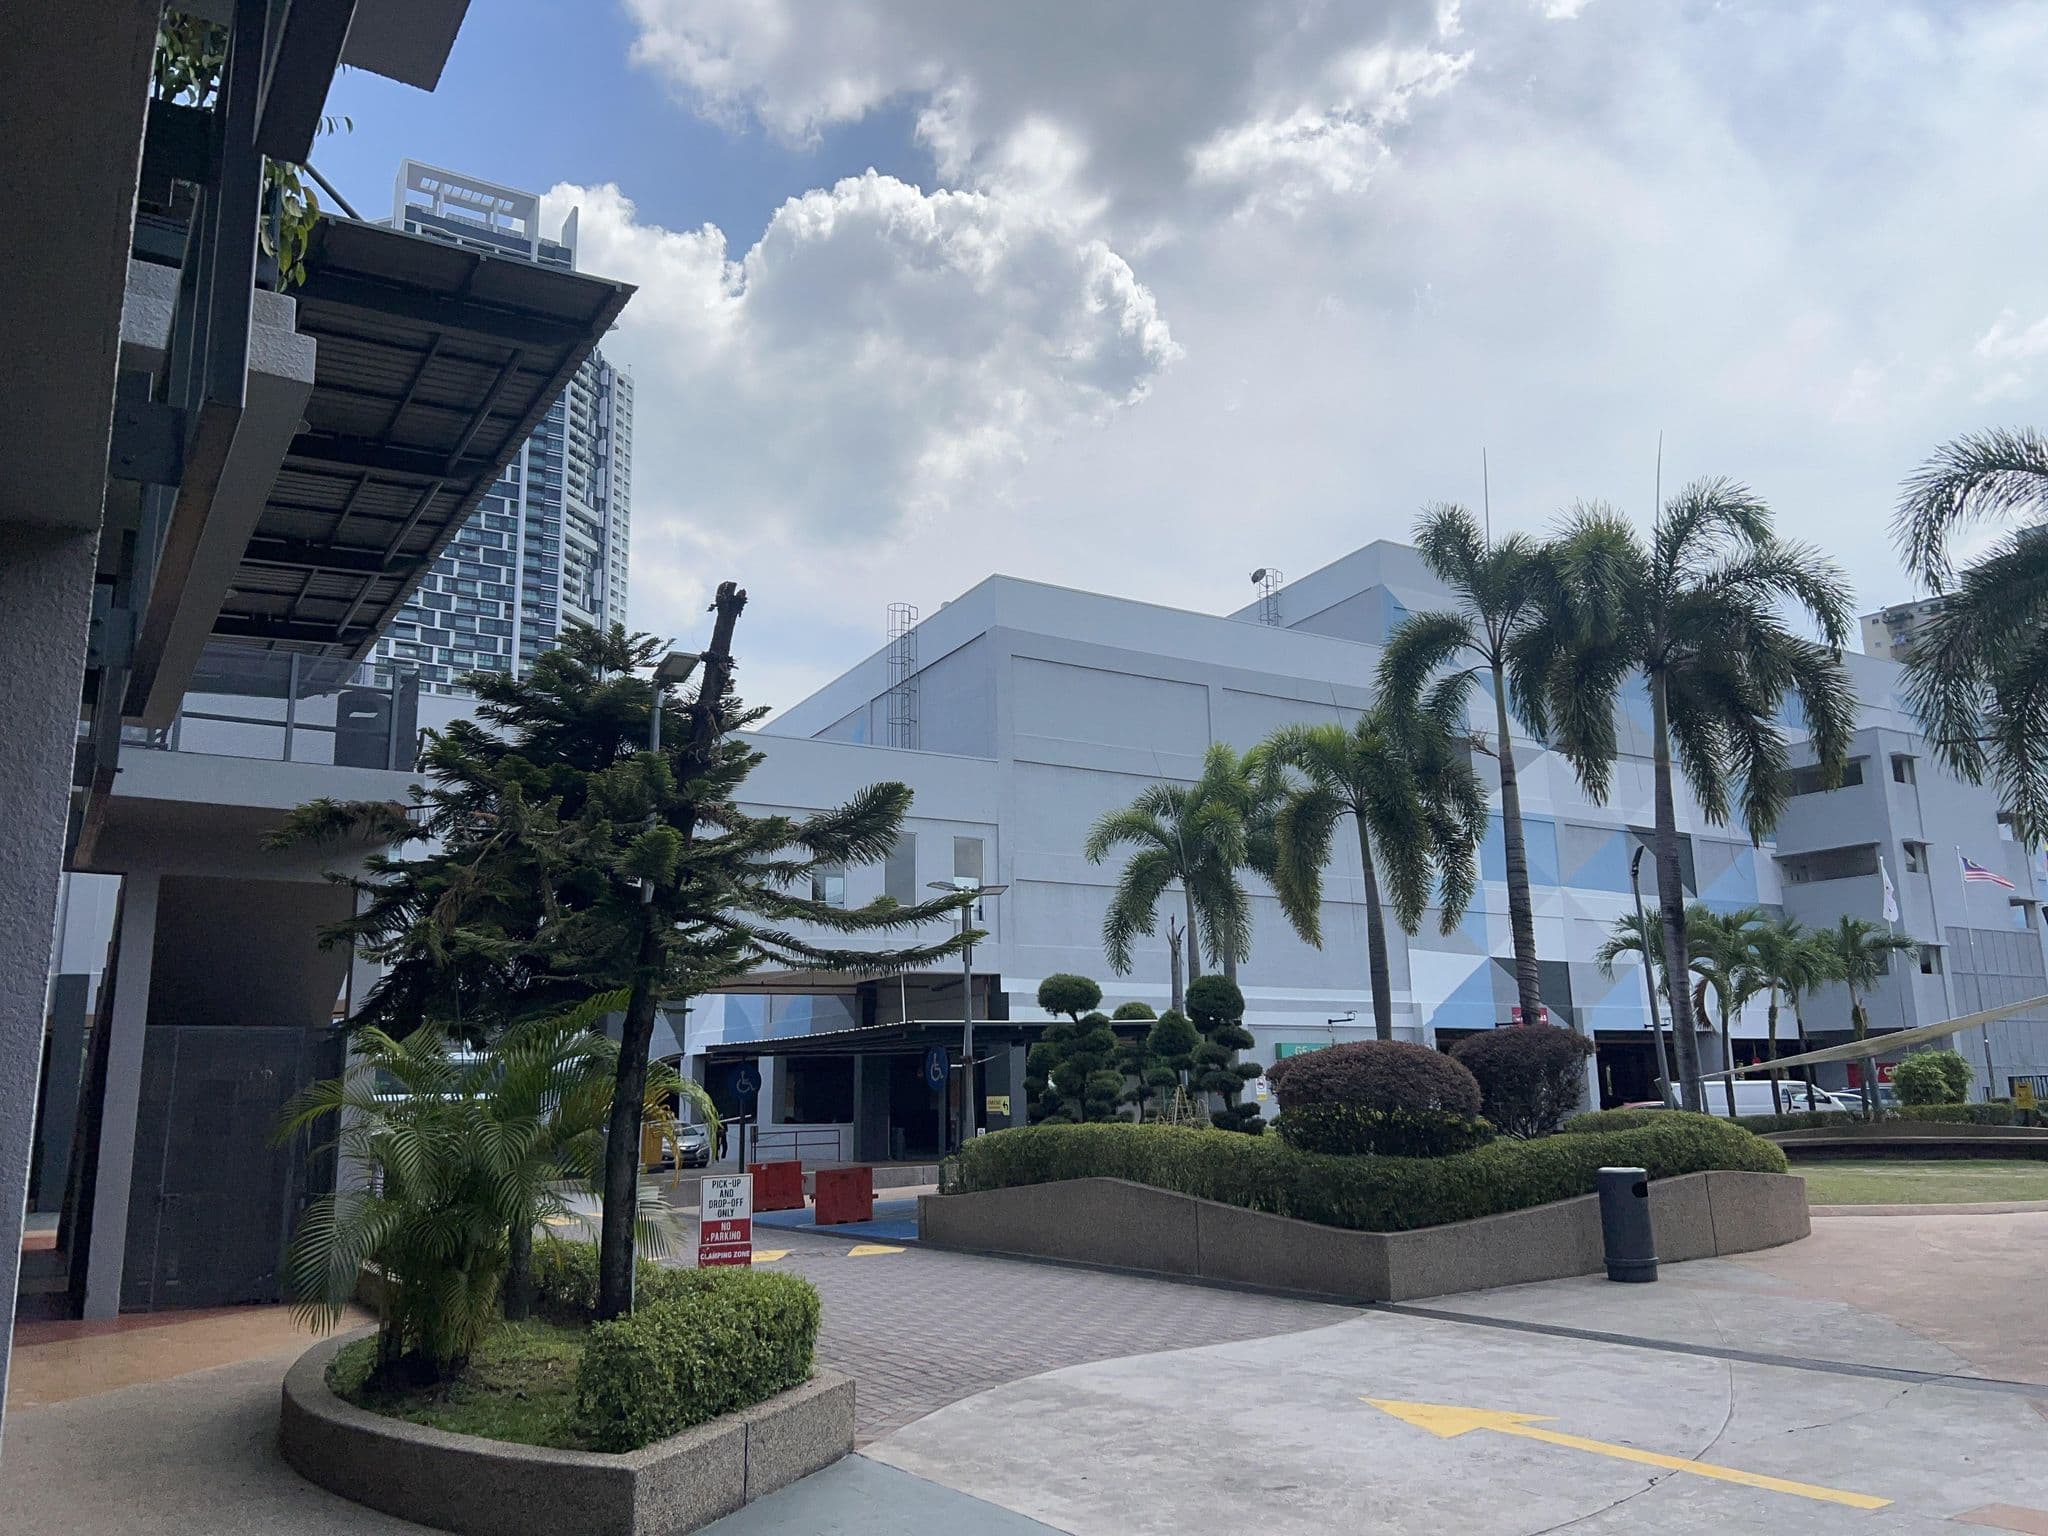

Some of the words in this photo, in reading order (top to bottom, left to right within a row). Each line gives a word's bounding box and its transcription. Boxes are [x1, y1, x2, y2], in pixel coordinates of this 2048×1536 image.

[712, 1179, 741, 1189] PICK-UP
[720, 1189, 734, 1198] AND
[708, 1198, 743, 1209] DROP-OFF
[717, 1208, 735, 1218] ONLY
[721, 1221, 731, 1231] NO
[710, 1231, 741, 1242] PARKING
[700, 1251, 732, 1260] CLAMPING
[733, 1250, 750, 1258] ZONE
